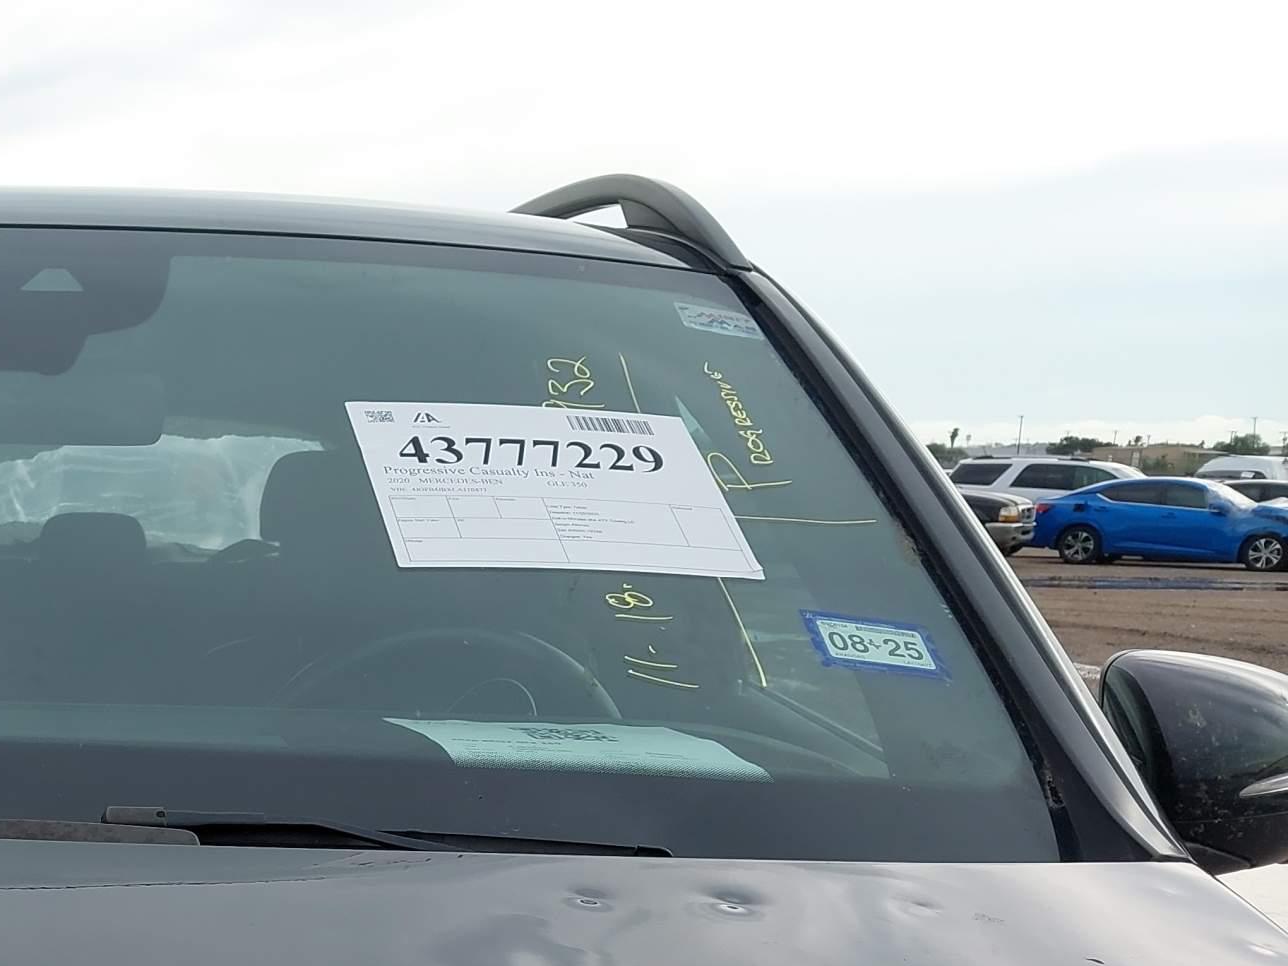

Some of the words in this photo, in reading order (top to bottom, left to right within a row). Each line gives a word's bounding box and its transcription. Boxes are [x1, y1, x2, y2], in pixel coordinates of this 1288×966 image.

[398, 435, 664, 474] 43777229
[383, 465, 467, 477] Progressive
[469, 466, 530, 478] Casualty
[534, 468, 555, 478] Ins
[568, 469, 596, 480] Nat
[827, 631, 870, 654] 08
[882, 638, 924, 661] 25
